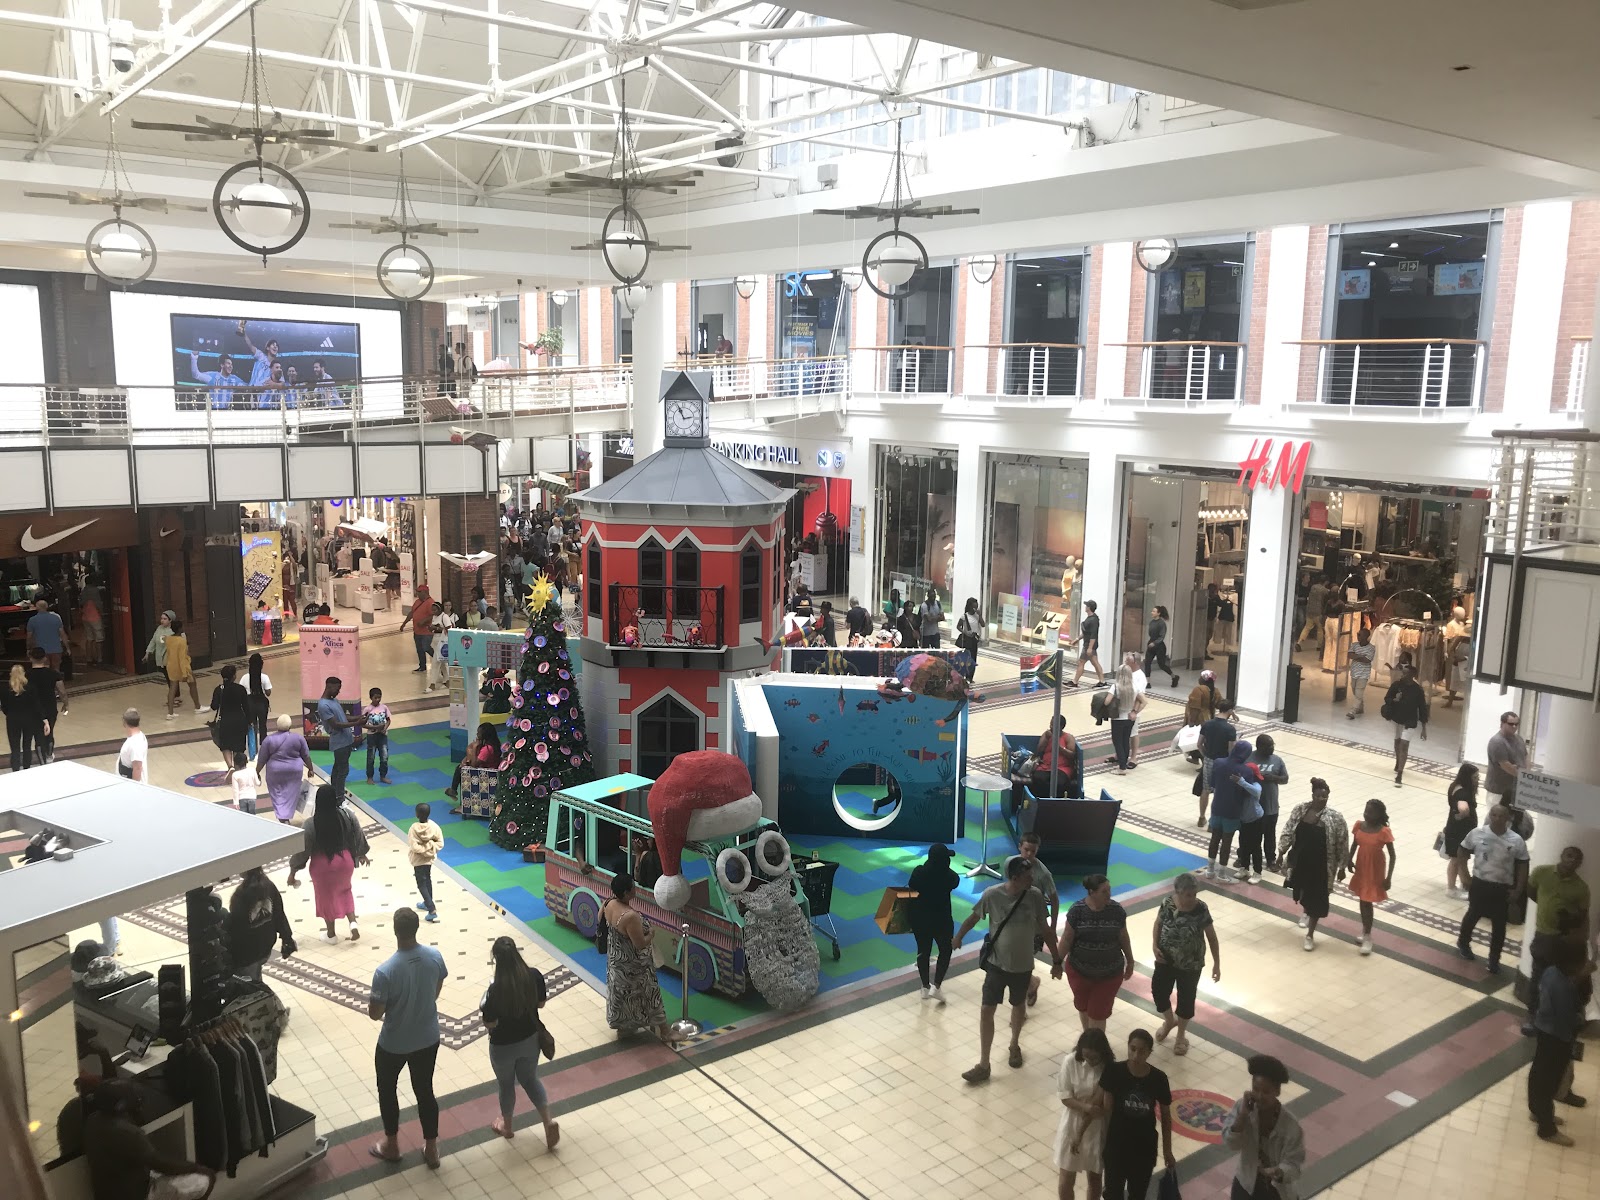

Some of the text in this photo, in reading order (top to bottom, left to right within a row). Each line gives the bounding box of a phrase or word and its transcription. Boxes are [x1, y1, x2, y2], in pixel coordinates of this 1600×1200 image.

[768, 446, 802, 465] HALL
[1237, 438, 1313, 495] H&M
[305, 606, 320, 614] sale
[320, 634, 331, 643] Joy
[1521, 772, 1560, 786] TOILETS
[1517, 799, 1531, 809] Baby
[1532, 803, 1554, 815] Change
[1124, 1099, 1149, 1110] NASA
